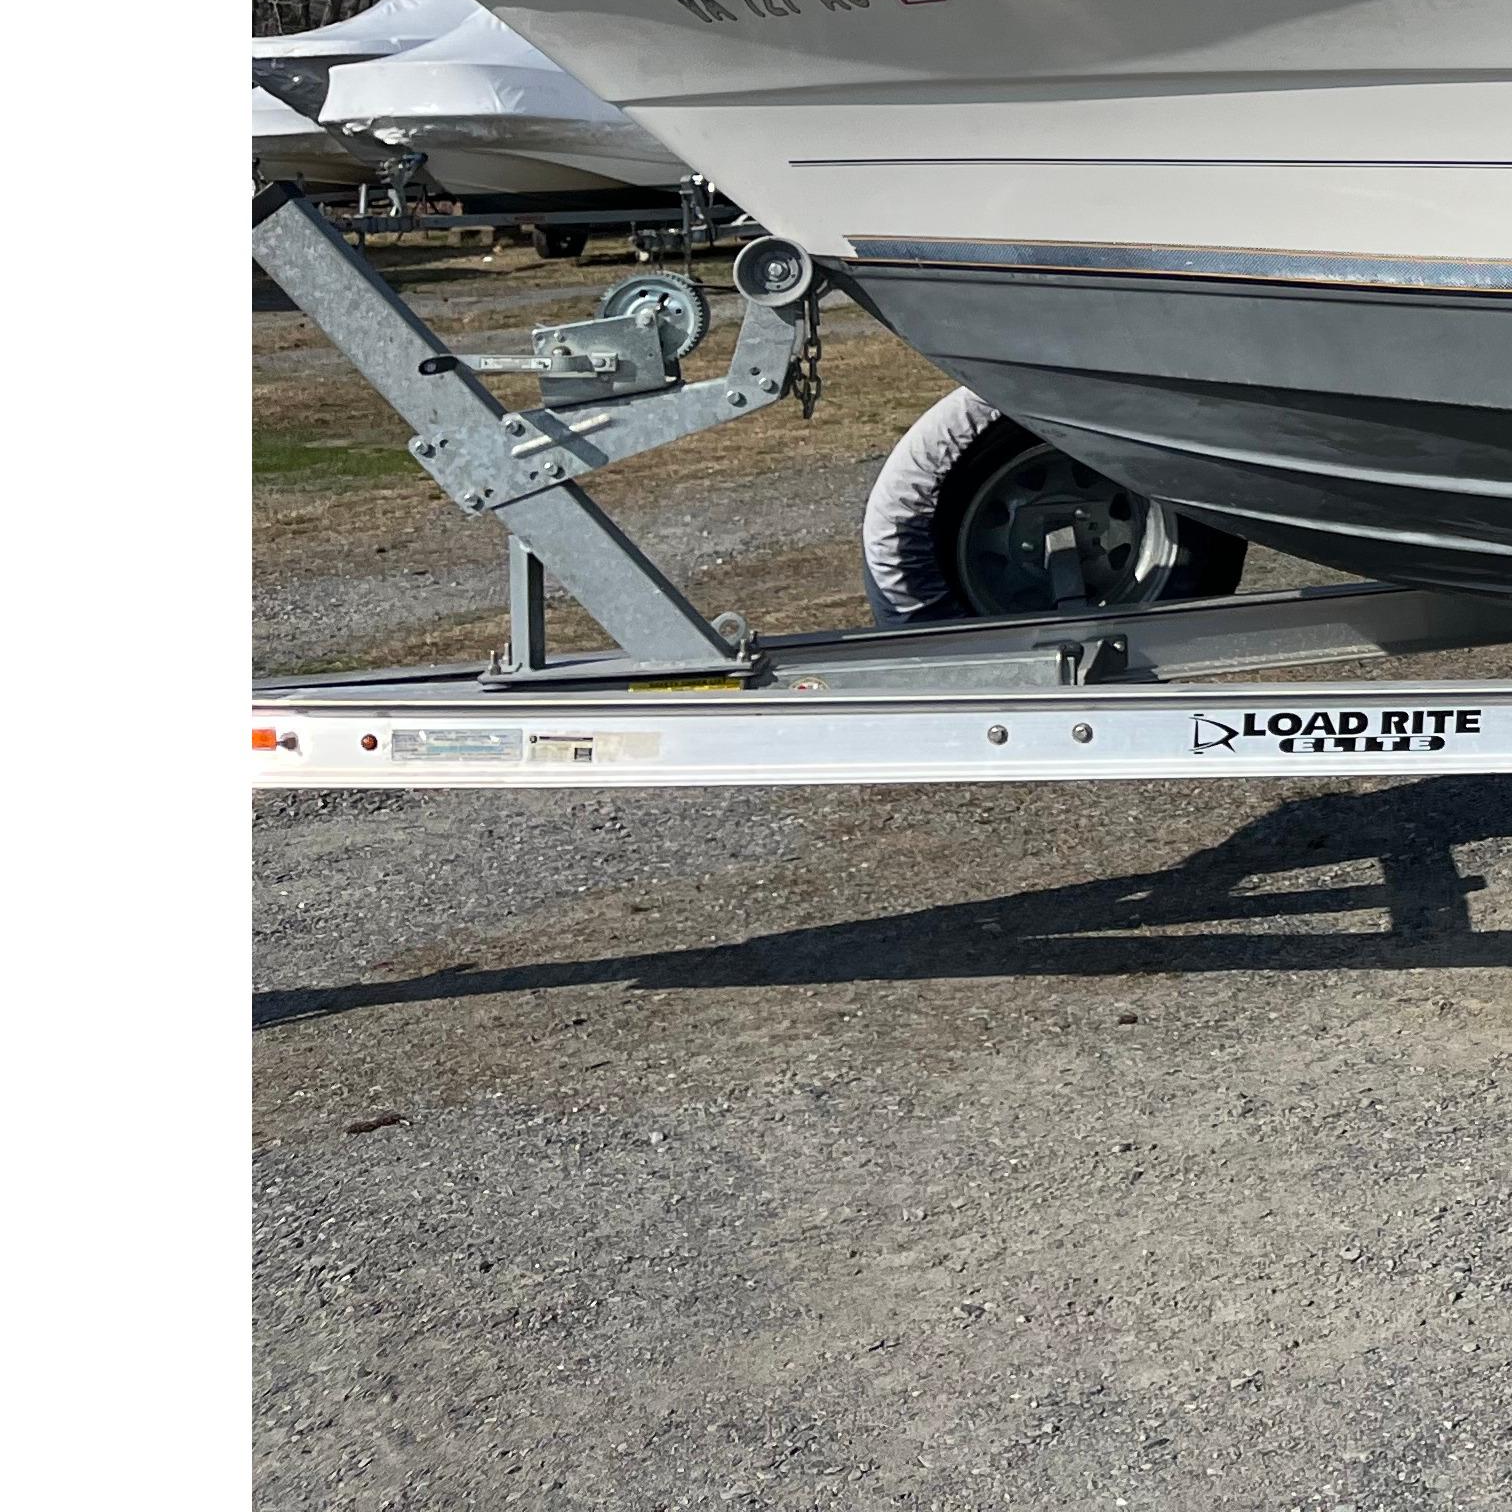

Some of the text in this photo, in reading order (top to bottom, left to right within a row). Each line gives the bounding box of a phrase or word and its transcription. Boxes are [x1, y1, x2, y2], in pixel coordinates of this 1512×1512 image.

[1242, 709, 1482, 737] LOAD RITE
[1291, 736, 1433, 753] ELITE
